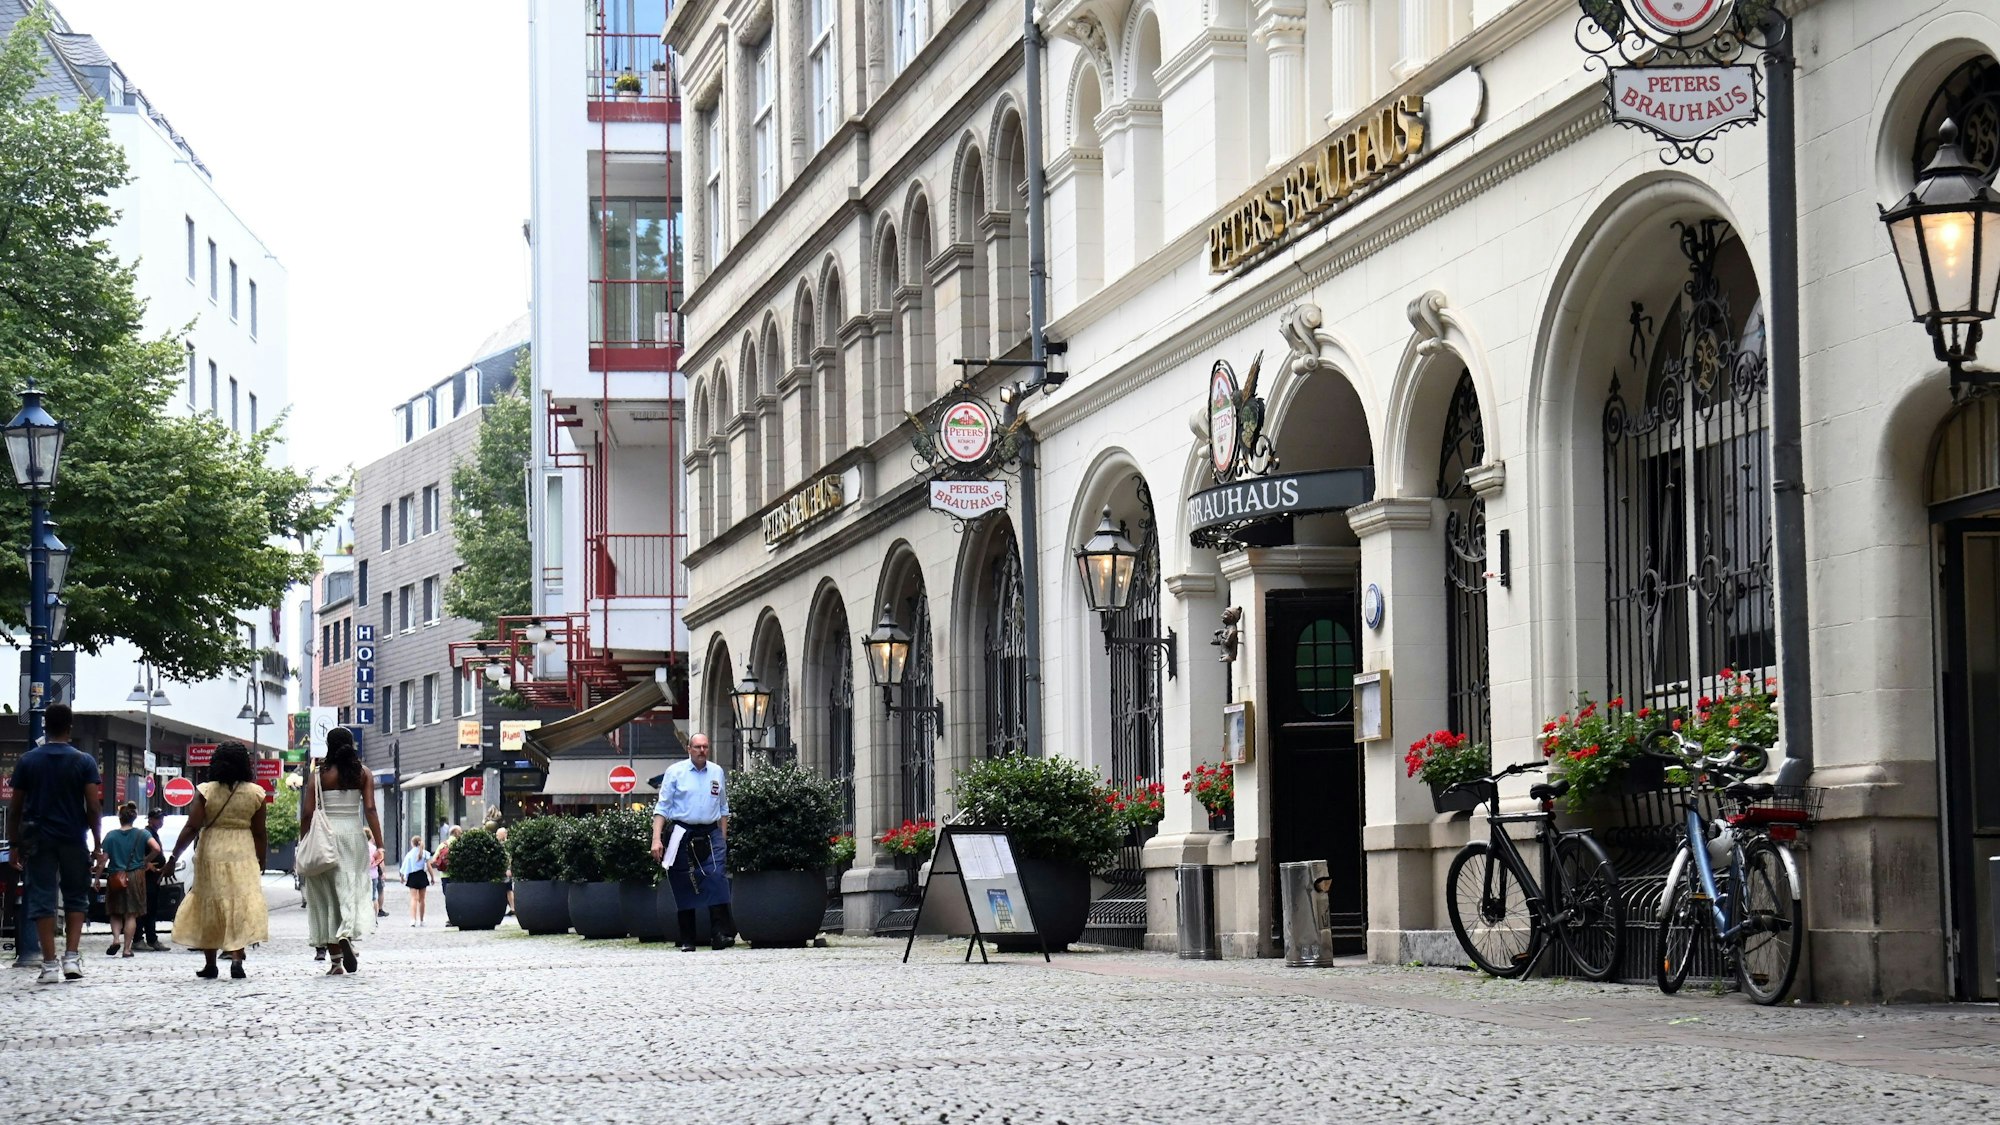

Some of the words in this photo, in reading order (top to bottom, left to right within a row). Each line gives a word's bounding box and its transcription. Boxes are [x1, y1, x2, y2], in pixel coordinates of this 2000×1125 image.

[1647, 75, 1721, 93] PETERS
[1620, 85, 1748, 122] BRAUHAUS
[1209, 186, 1286, 274] PETERS
[1283, 95, 1425, 228] BRAUHAUS
[949, 427, 984, 437] PETERS
[934, 489, 1004, 510] BRAUHAUS
[949, 484, 989, 494] PETERS
[1189, 478, 1299, 527] BRAUHAUS
[358, 626, 373, 723] HOTEL
